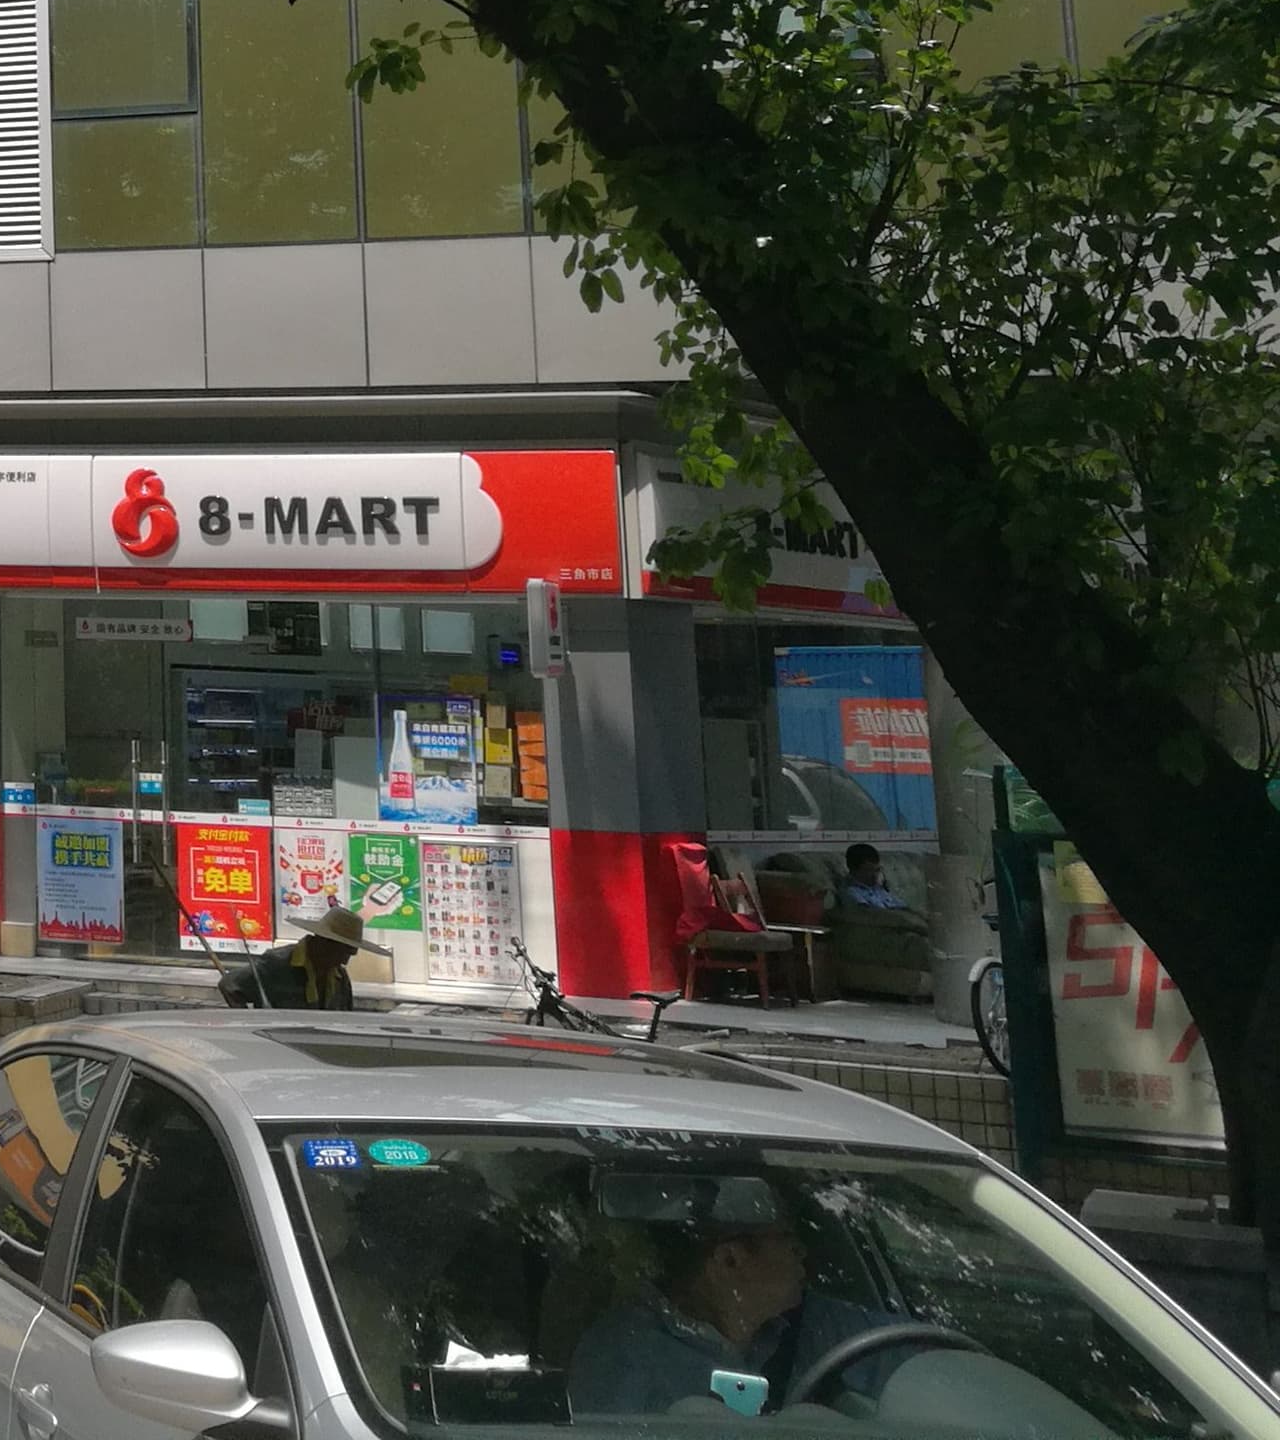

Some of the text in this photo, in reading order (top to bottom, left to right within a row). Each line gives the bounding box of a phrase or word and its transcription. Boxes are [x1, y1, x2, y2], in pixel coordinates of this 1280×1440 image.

[198, 495, 440, 544] 8-MART
[559, 567, 613, 580] 三角市店
[205, 867, 253, 893] 免单
[315, 1156, 357, 1166] 2019
